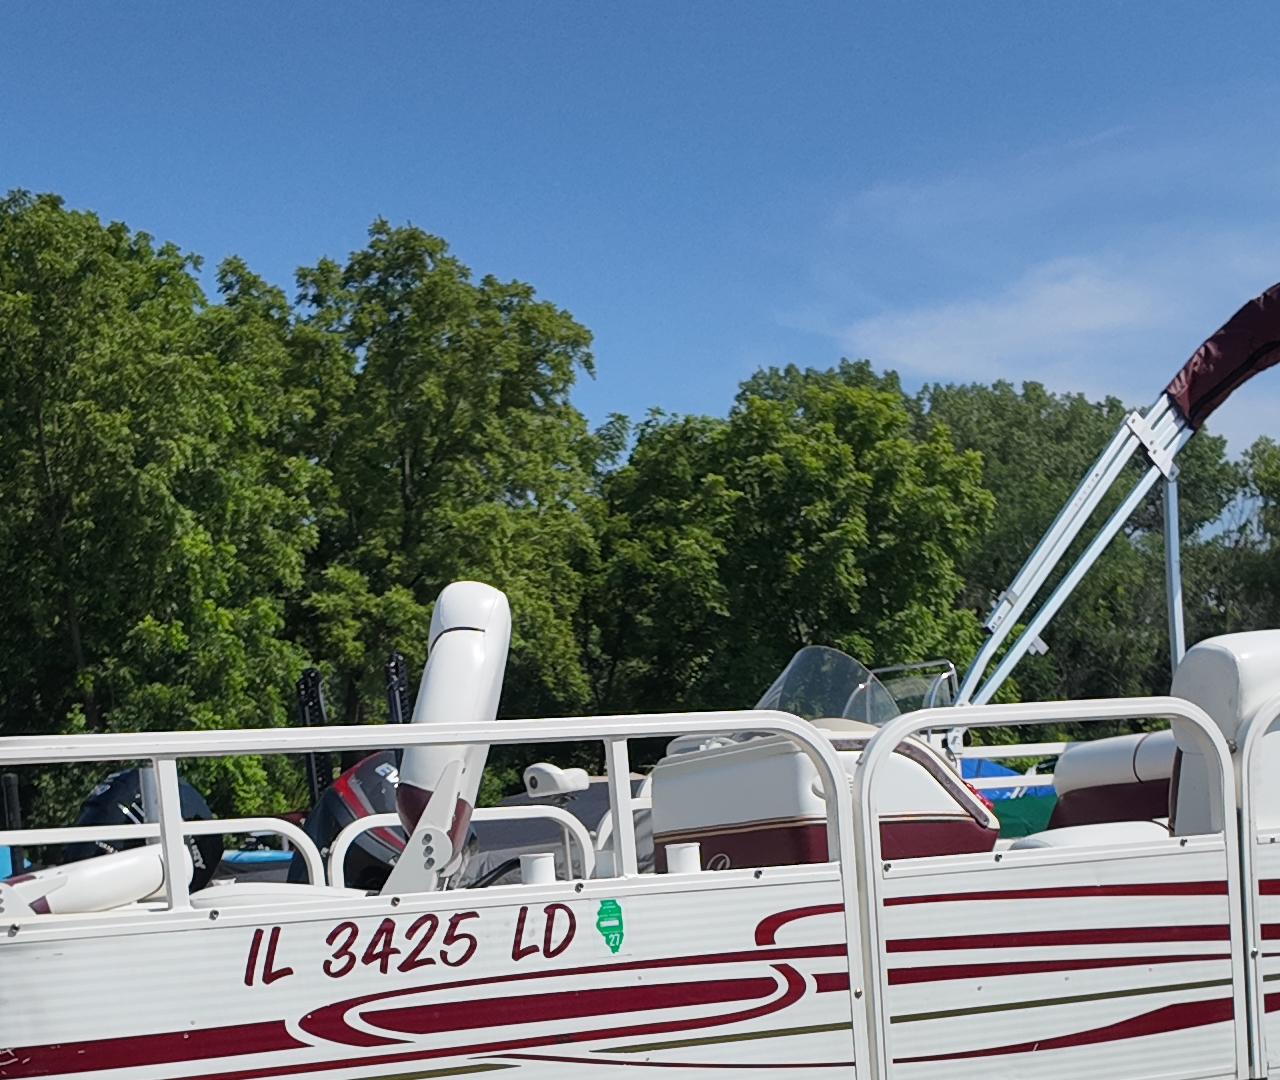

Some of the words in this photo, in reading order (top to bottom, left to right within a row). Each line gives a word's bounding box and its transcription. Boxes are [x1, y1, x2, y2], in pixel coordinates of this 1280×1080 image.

[244, 926, 294, 987] IL
[322, 910, 480, 979] 3425
[511, 903, 577, 962] LD
[609, 933, 620, 947] 27
